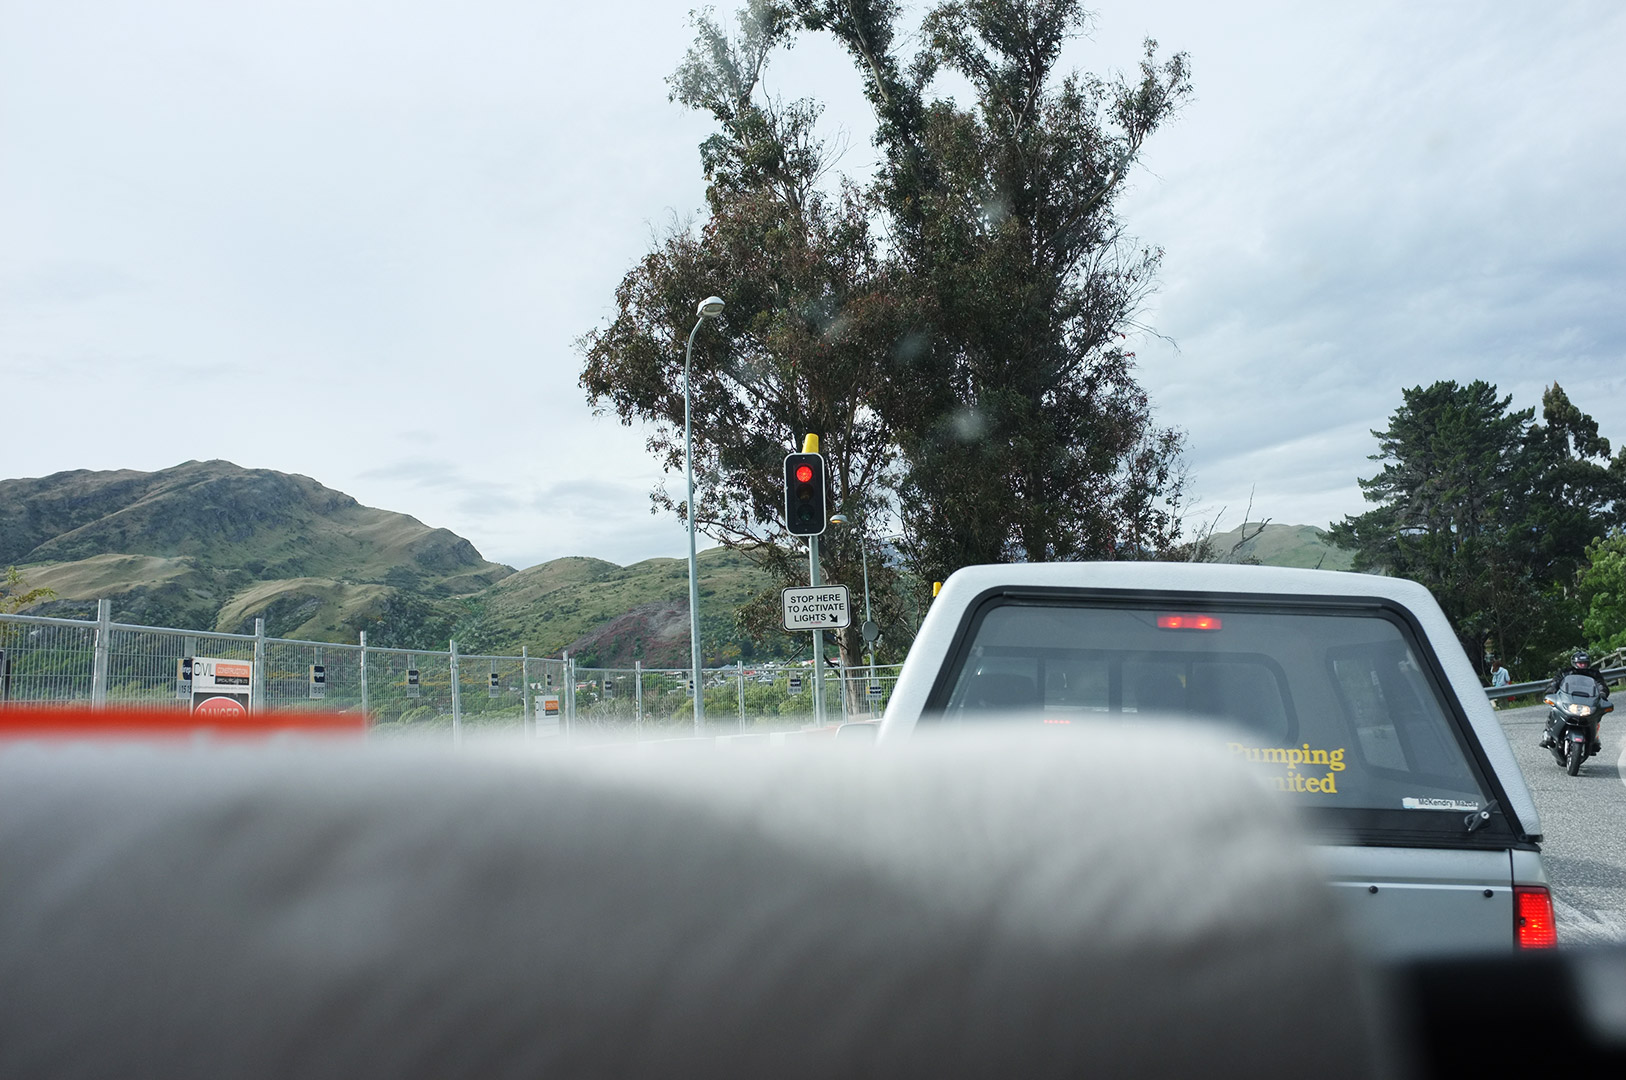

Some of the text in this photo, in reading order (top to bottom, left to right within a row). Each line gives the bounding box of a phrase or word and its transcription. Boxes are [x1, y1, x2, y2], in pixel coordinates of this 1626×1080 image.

[790, 593, 841, 603] STOP HERE
[787, 603, 845, 613] TO ACTIVATE
[794, 613, 827, 622] LIGHTS
[1226, 742, 1346, 772] Pumping
[1418, 798, 1453, 808] McKendry
